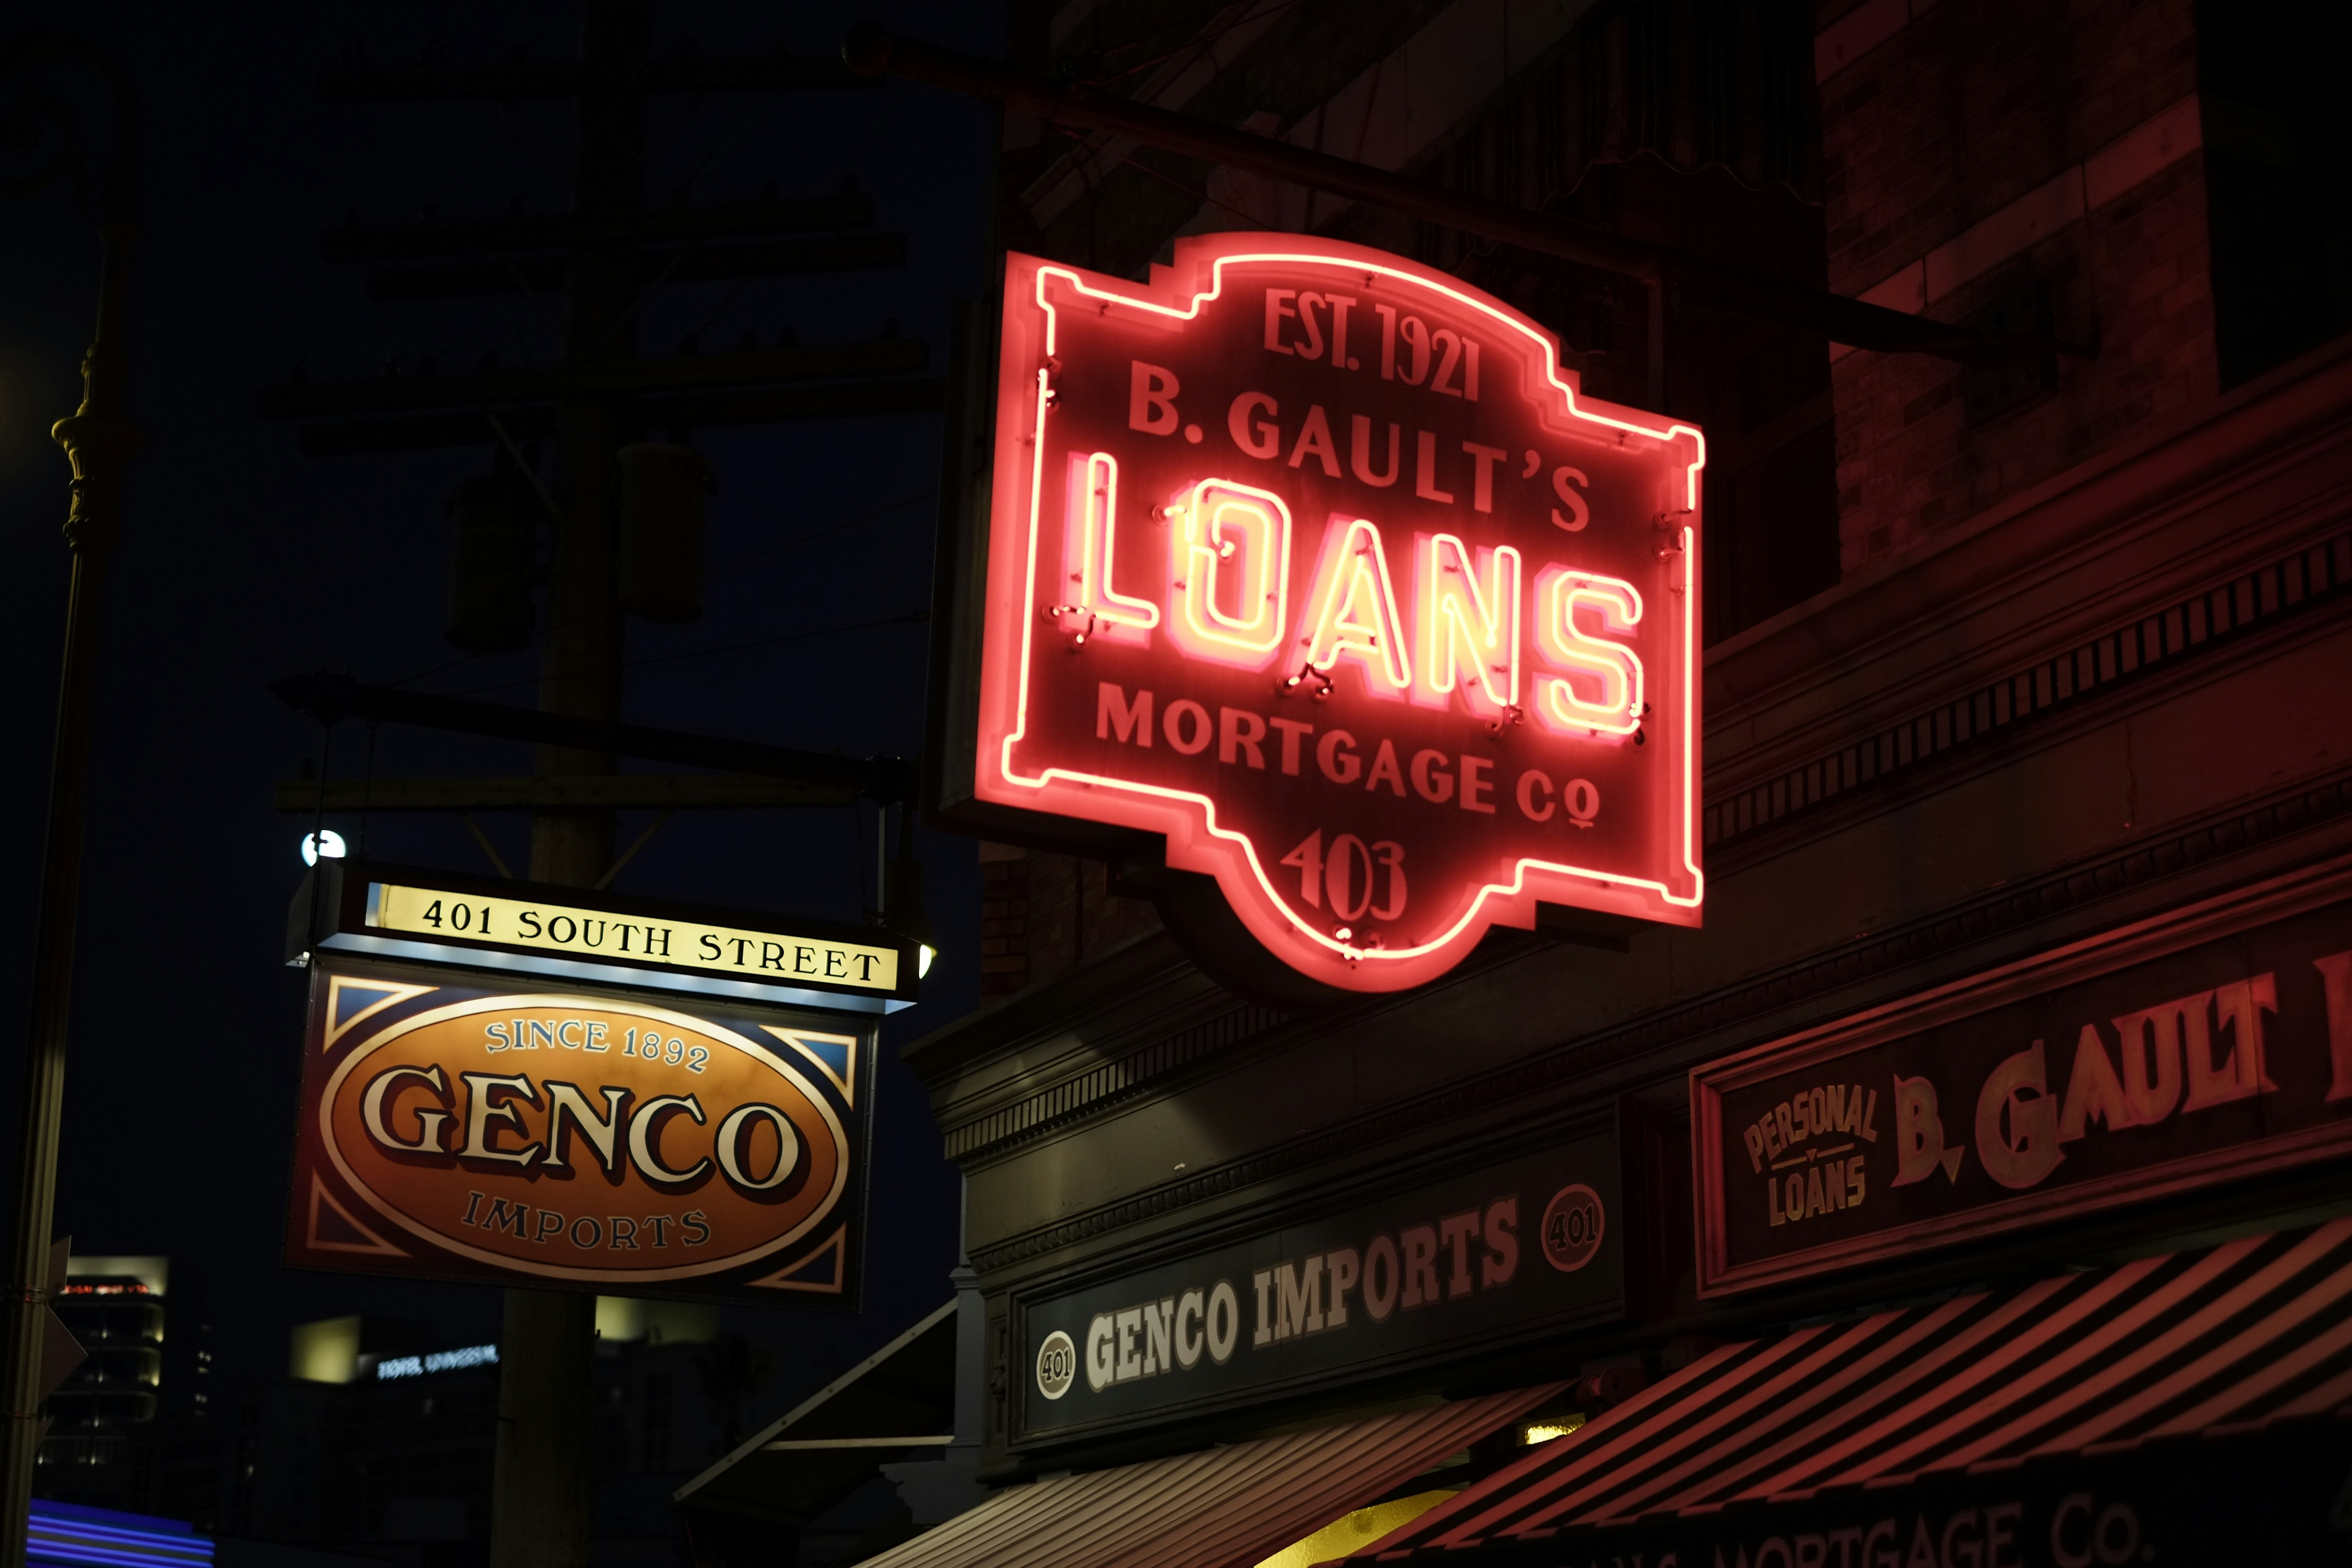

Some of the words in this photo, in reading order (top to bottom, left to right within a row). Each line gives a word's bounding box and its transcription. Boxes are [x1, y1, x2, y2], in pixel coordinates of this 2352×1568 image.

[1264, 287, 1360, 371] EST.
[1375, 302, 1479, 402] 1921
[1129, 358, 1203, 444] B.
[1227, 390, 1590, 532] GAULT'S
[1059, 451, 1643, 745] LOANS
[1096, 682, 1496, 815] MORTGAGE
[1279, 827, 1408, 922] 403
[423, 900, 492, 934] 401
[518, 910, 672, 957] SOUTH
[699, 933, 882, 983] STREET
[484, 1019, 608, 1053] SINCE
[623, 1027, 710, 1074] 1892
[1975, 971, 2279, 1189] GAULT
[360, 1064, 805, 1196] GENCO
[1743, 1084, 1878, 1175] PERSONAL
[462, 1190, 711, 1250] IMPORTS
[1547, 1203, 1597, 1251] 401
[1767, 1154, 1867, 1227] LOANS
[1086, 1278, 1239, 1392] GENCO
[1253, 1192, 1520, 1351] IMPORTS
[1040, 1348, 1072, 1383] 401
[2049, 1490, 2156, 1568] Co.
